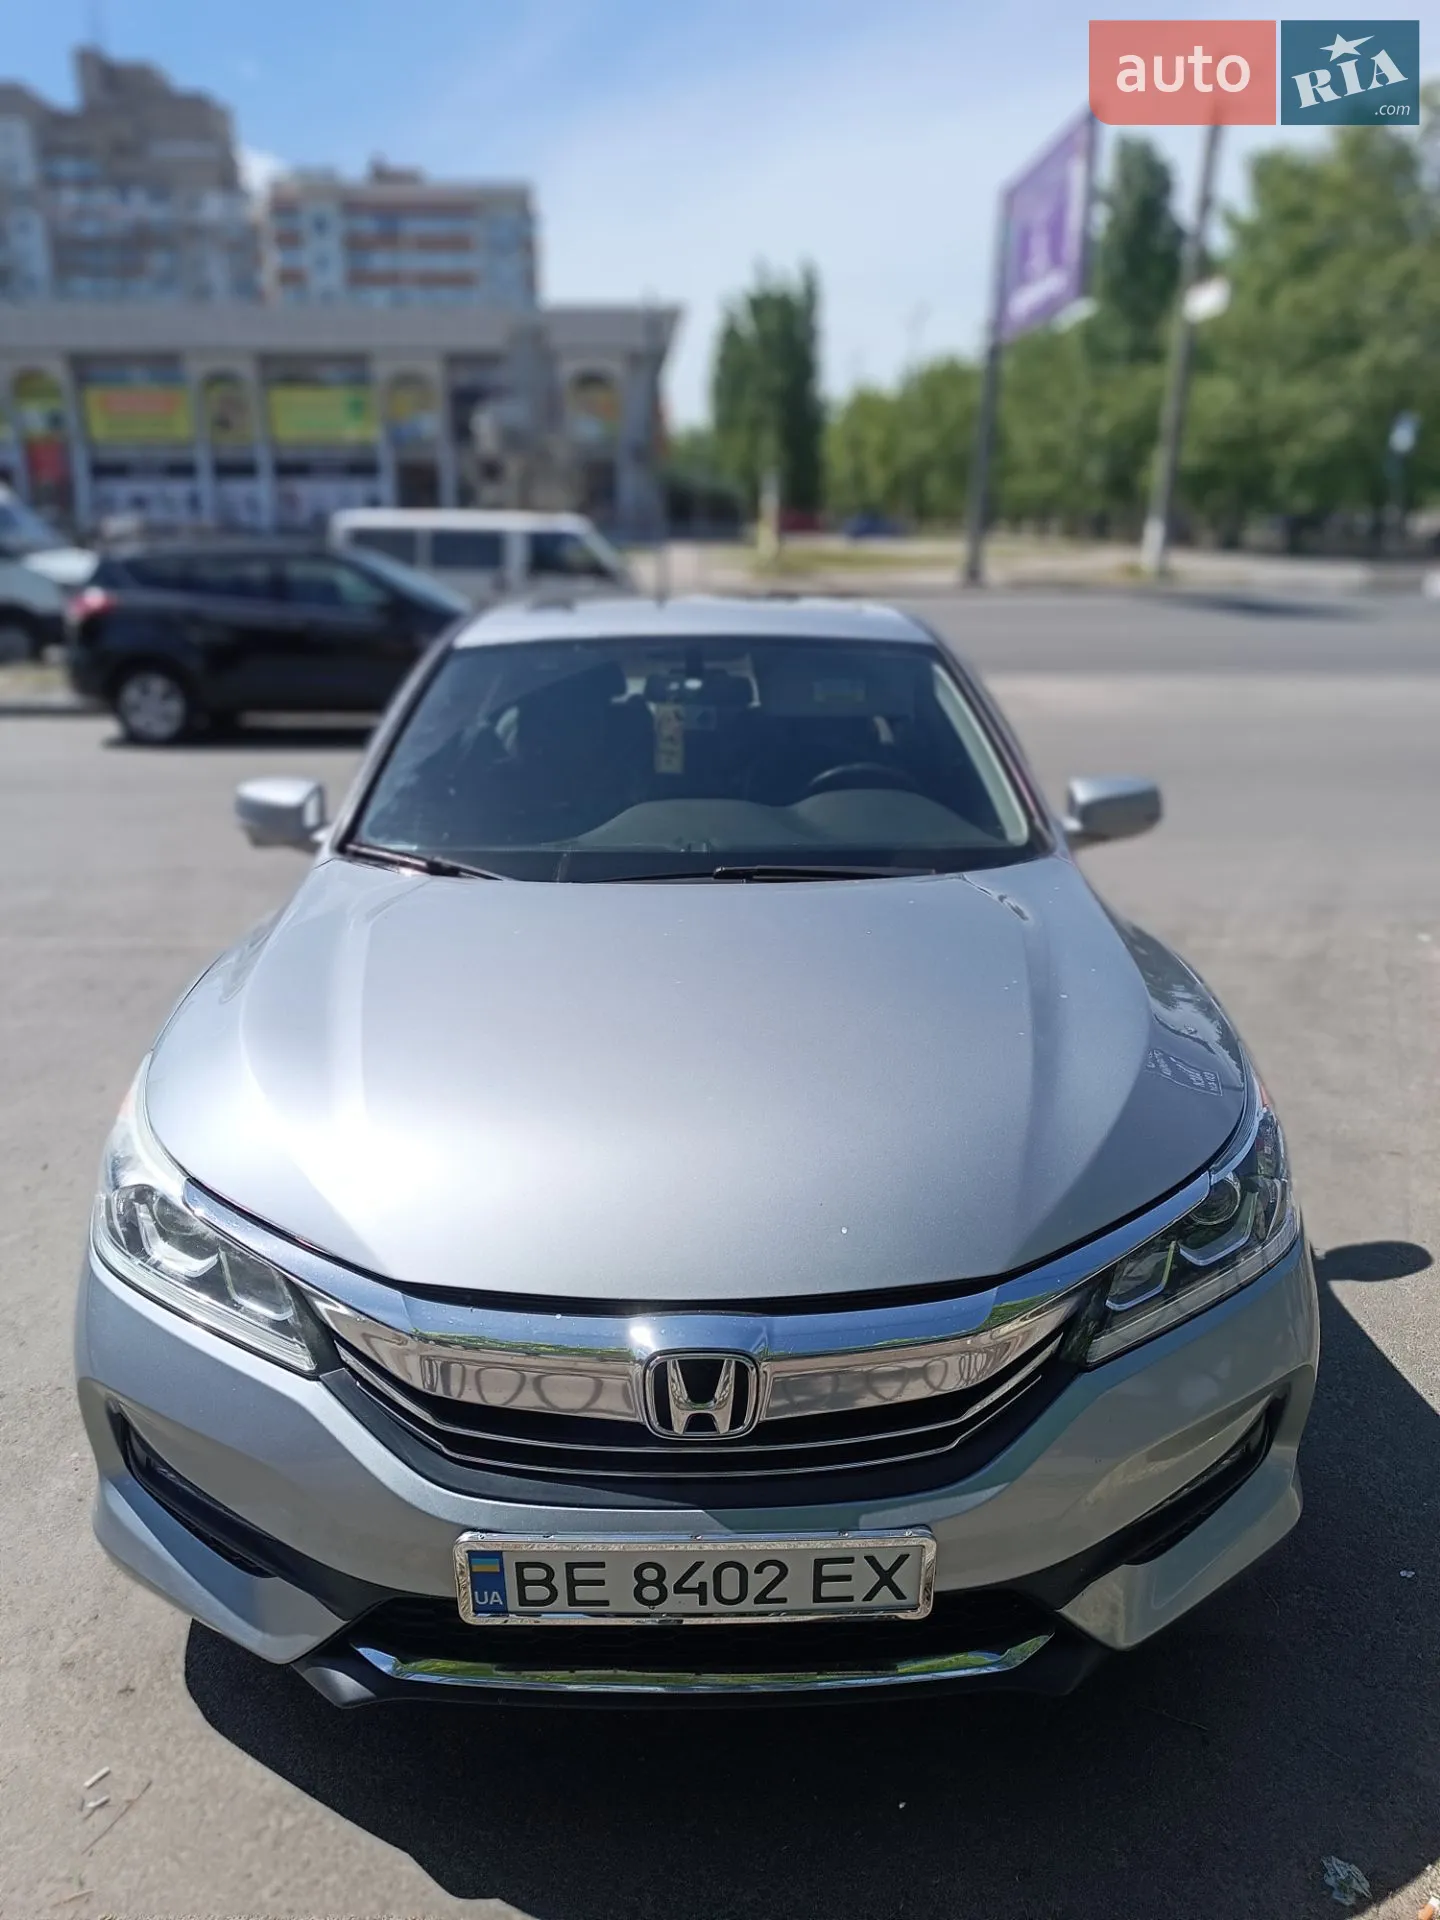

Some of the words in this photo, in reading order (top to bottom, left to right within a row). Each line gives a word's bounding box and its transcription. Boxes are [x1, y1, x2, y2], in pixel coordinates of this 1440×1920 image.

[514, 1560, 607, 1607] BE
[633, 1559, 789, 1607] 8402
[812, 1553, 911, 1603] EX
[475, 1591, 504, 1606] UA
